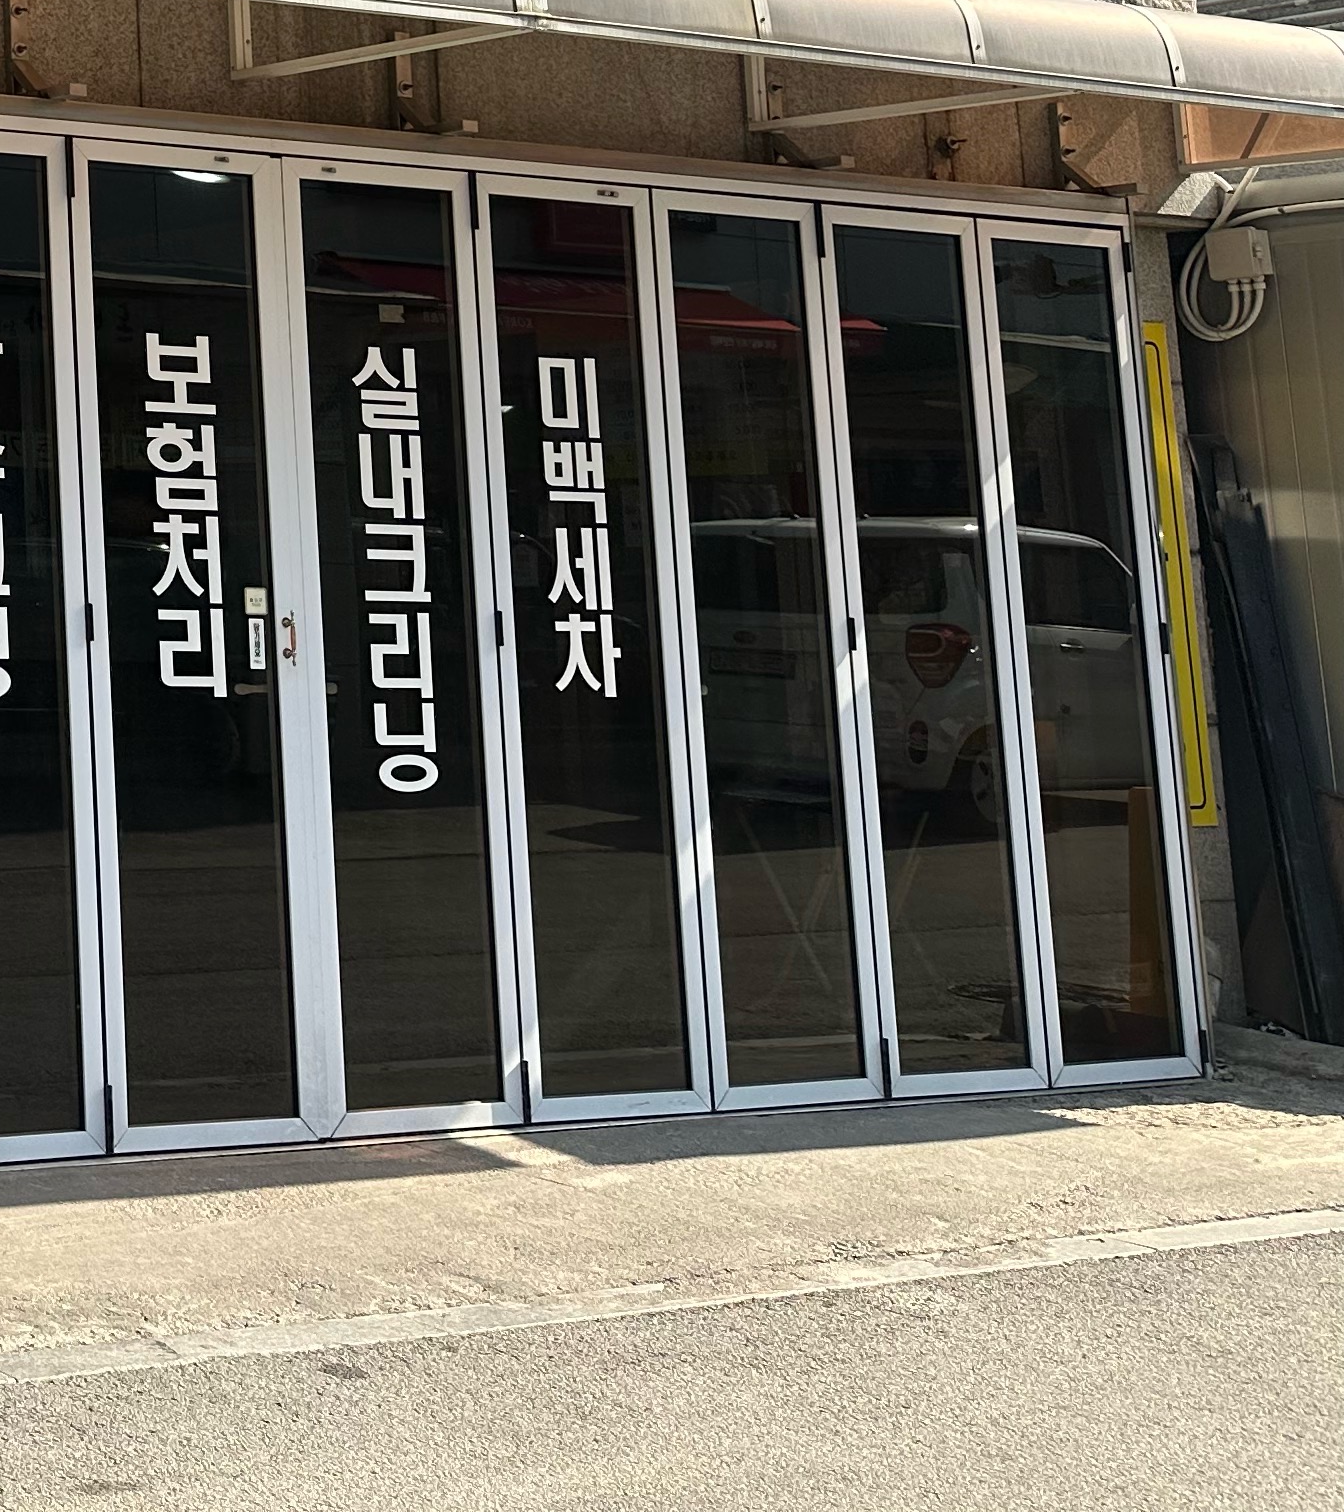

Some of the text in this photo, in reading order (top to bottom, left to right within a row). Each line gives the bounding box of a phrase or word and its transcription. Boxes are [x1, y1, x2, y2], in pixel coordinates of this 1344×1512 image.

[144, 332, 228, 698] 보험처리
[351, 346, 439, 793] 실내크리닝
[538, 356, 622, 698] 미백세차
